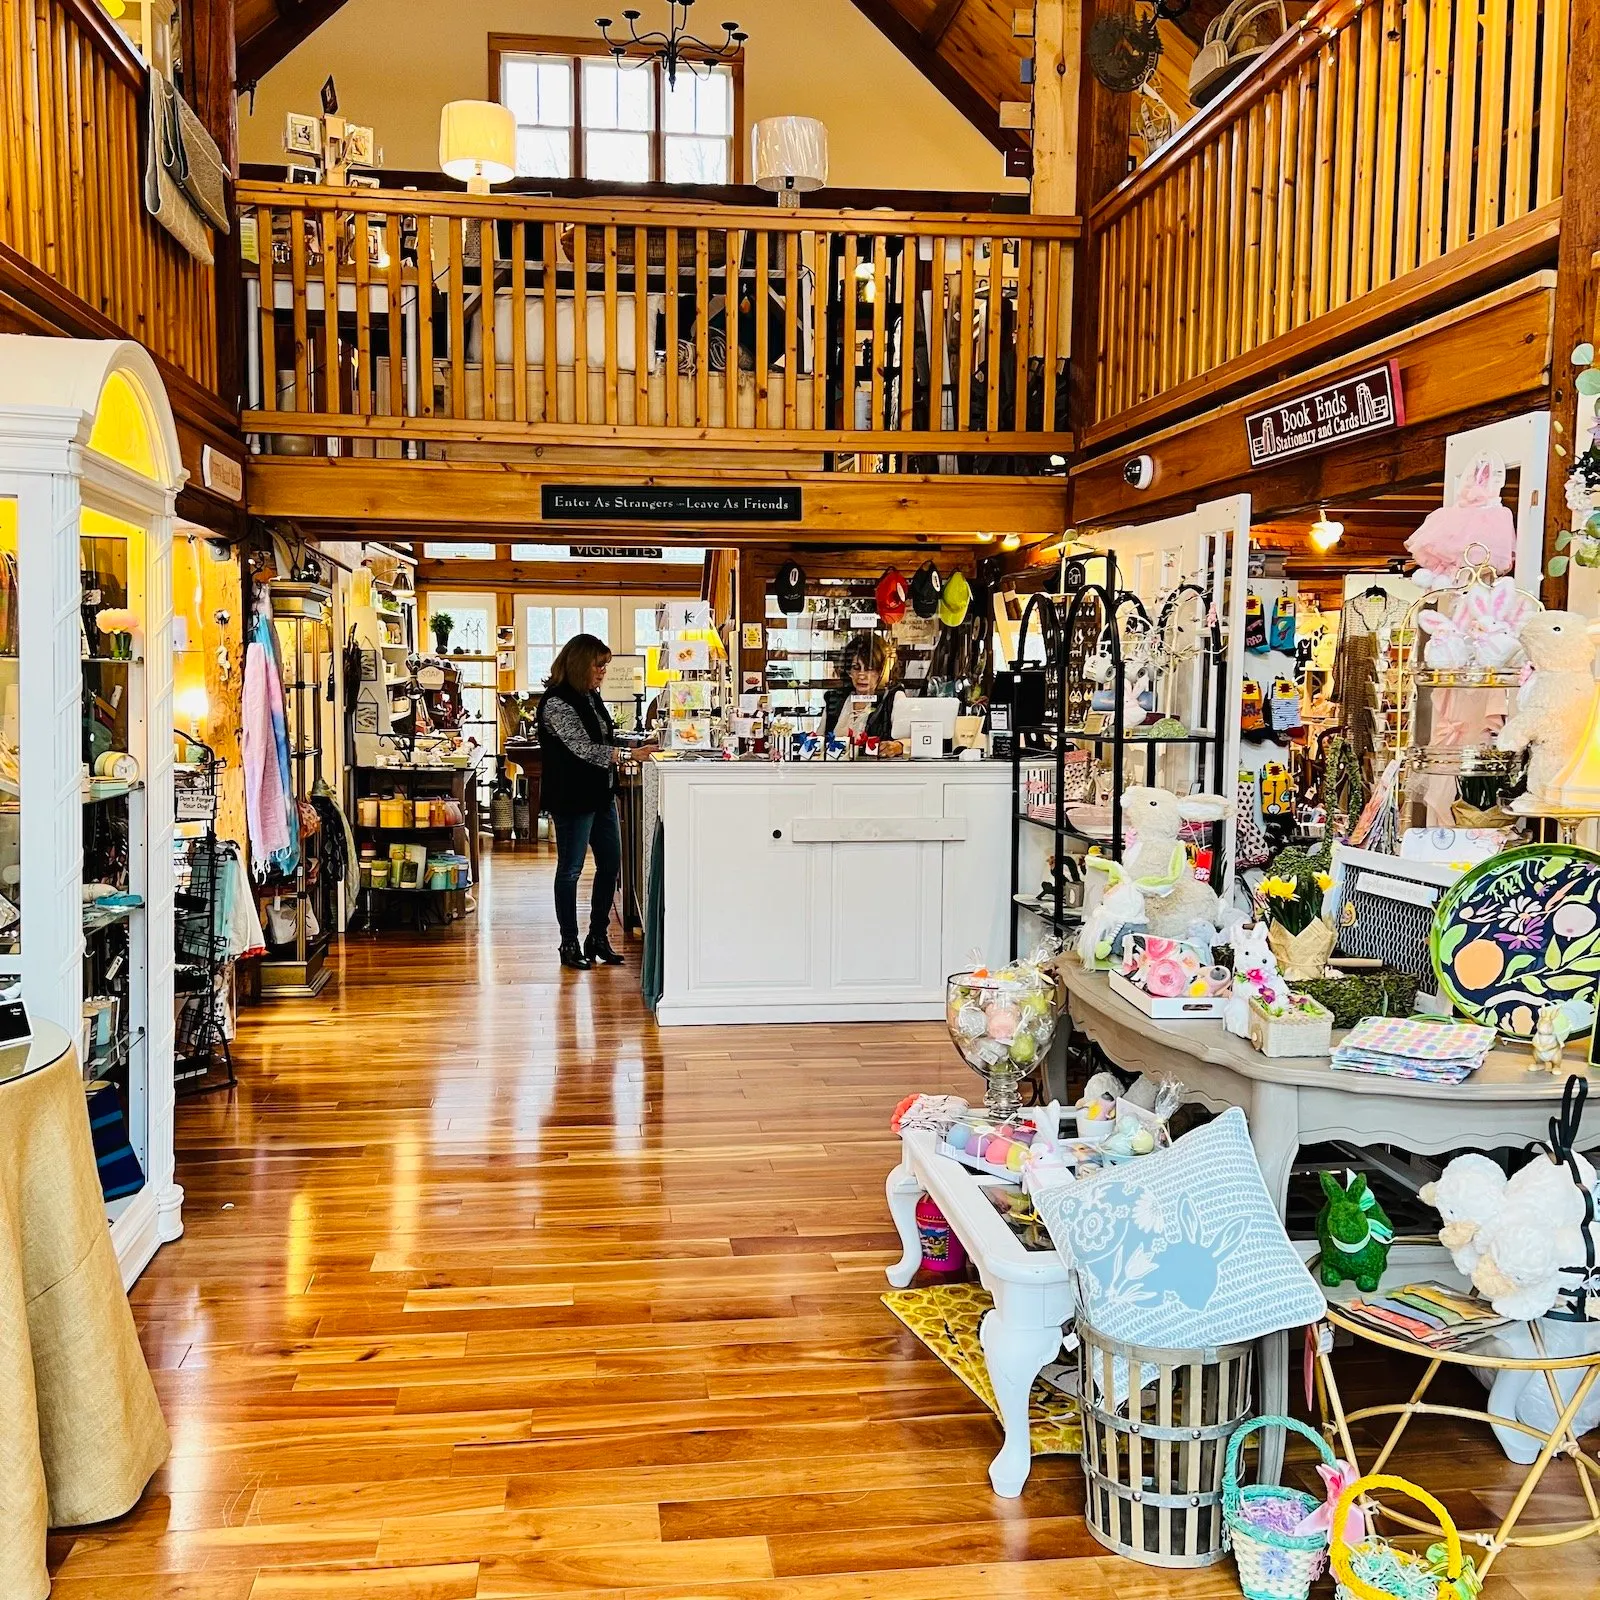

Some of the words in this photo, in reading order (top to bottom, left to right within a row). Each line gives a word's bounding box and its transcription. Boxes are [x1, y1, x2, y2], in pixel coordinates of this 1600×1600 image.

[1275, 431, 1317, 453] Stationary
[1317, 421, 1333, 439] and
[1333, 412, 1360, 434] Cards
[1280, 403, 1312, 434] Book
[1314, 390, 1348, 422] Ends
[555, 495, 590, 507] Enter
[594, 496, 610, 508] As
[614, 496, 673, 510] Strangers
[723, 498, 739, 509] As
[744, 496, 789, 510] Friends
